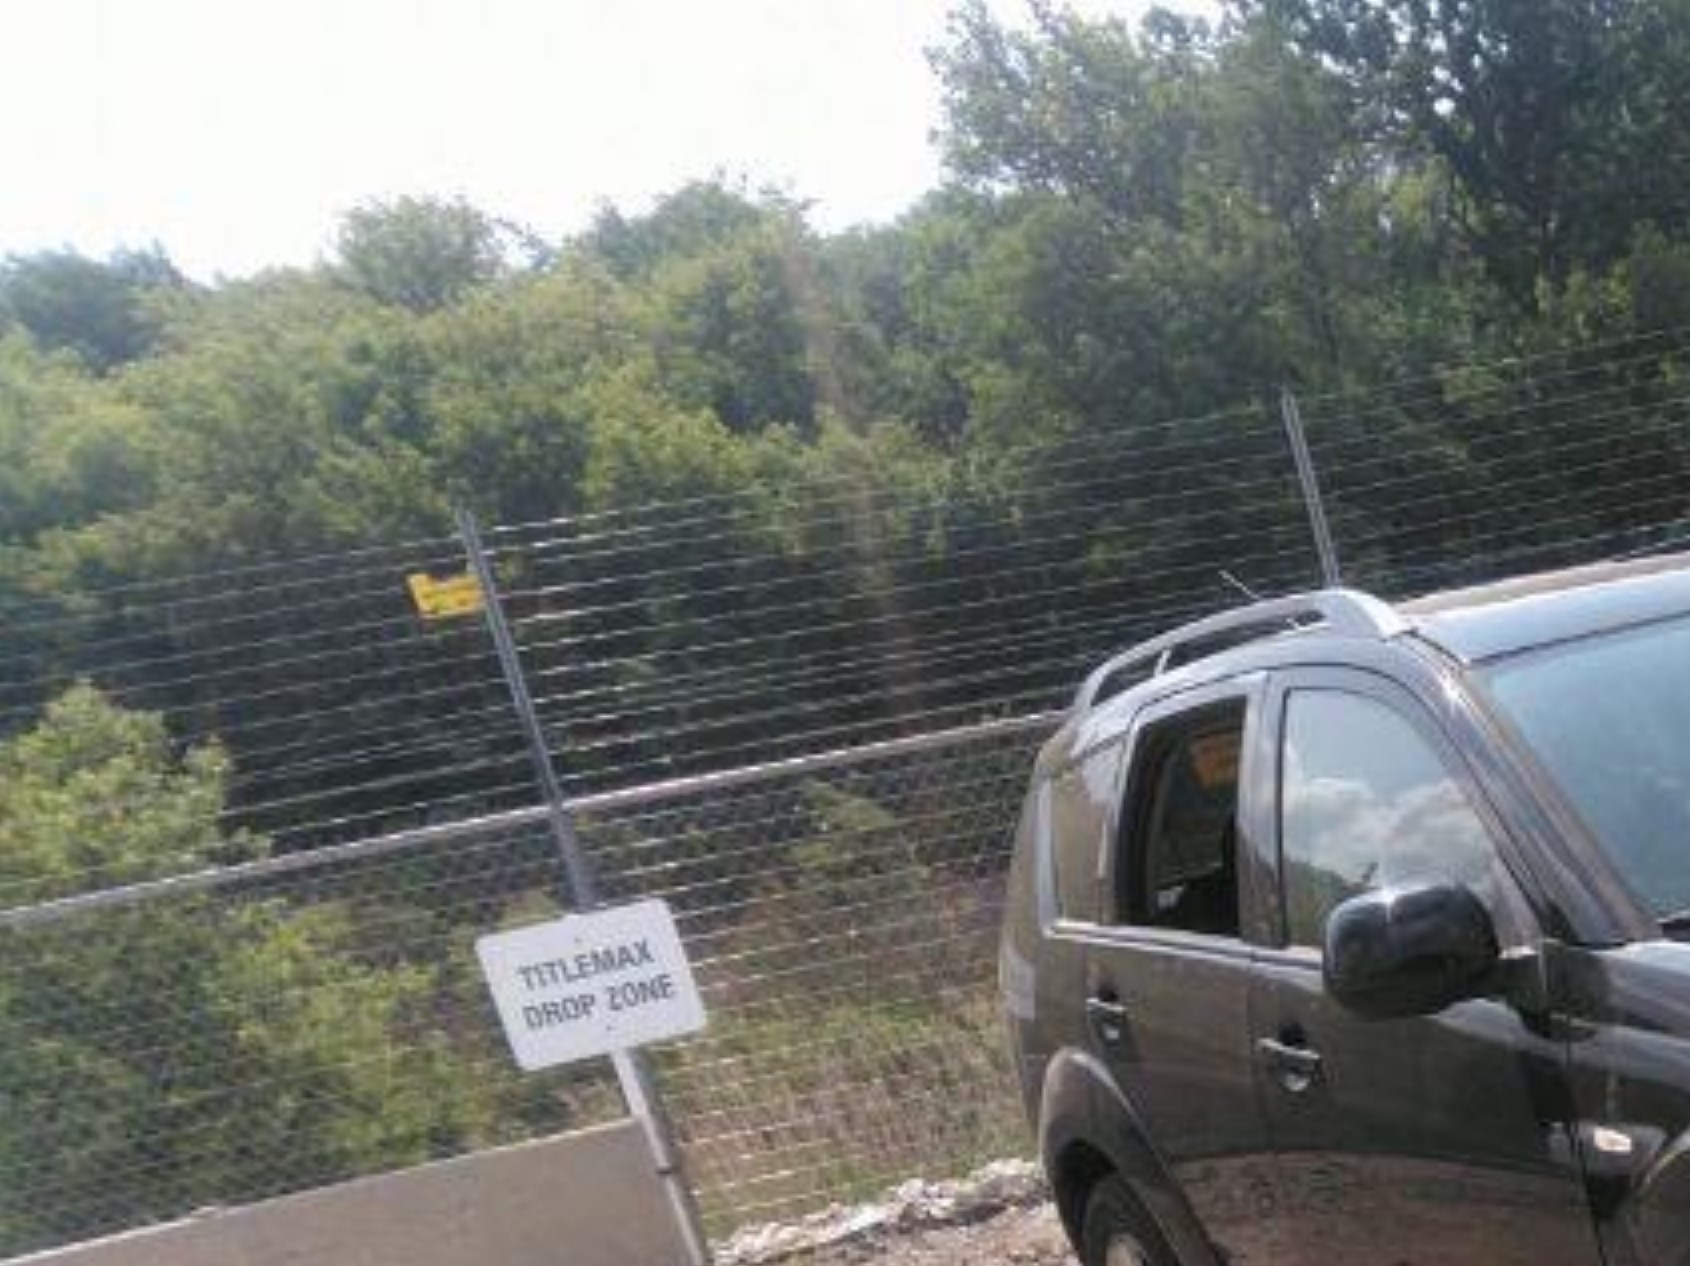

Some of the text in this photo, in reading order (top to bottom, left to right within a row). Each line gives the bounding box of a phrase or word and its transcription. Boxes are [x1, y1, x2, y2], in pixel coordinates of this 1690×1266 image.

[518, 938, 653, 990] TITLEMAX
[522, 973, 675, 1029] DROP ZONE
